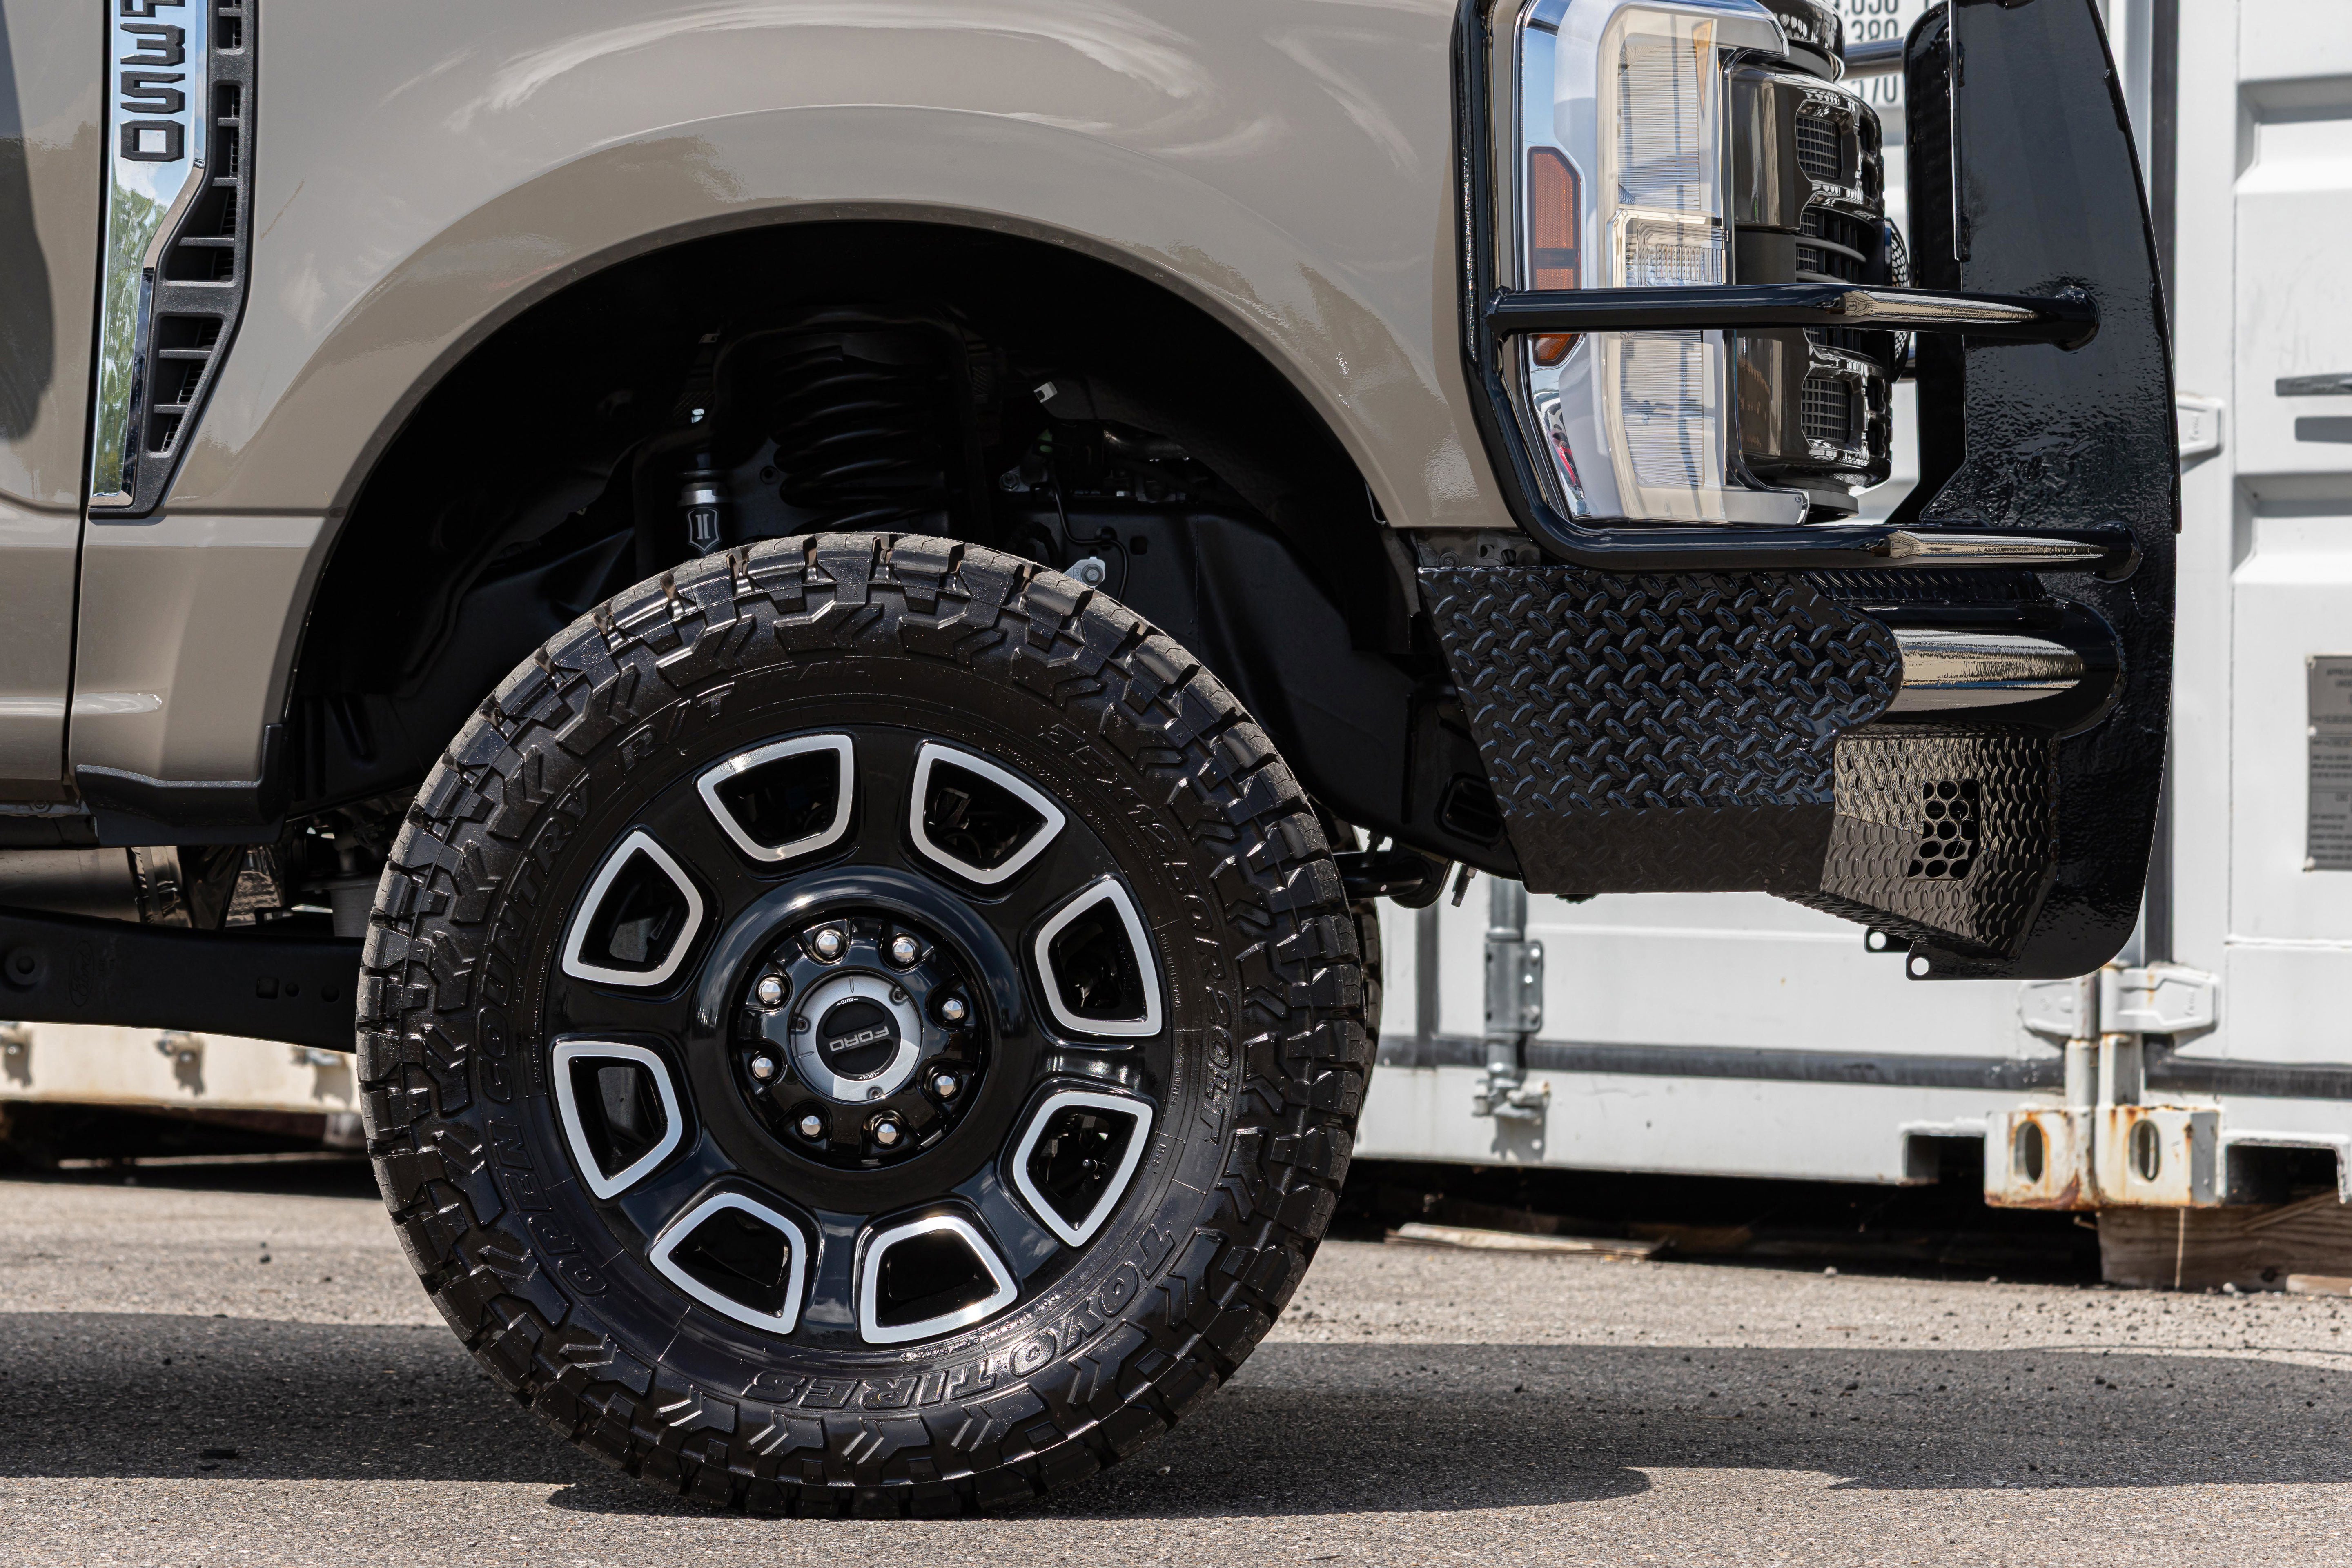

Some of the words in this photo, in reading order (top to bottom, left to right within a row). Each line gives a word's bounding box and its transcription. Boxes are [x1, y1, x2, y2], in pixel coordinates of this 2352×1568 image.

[616, 681, 736, 775] R/T
[477, 773, 591, 1103] COUNTRY
[840, 997, 854, 1005] AUTO
[829, 1025, 889, 1051] FORD
[1169, 1071, 1182, 1106] TUBELESS
[489, 1119, 608, 1296] OPEN
[1010, 1224, 1174, 1376] TOYO
[742, 1358, 999, 1410] TIRES
